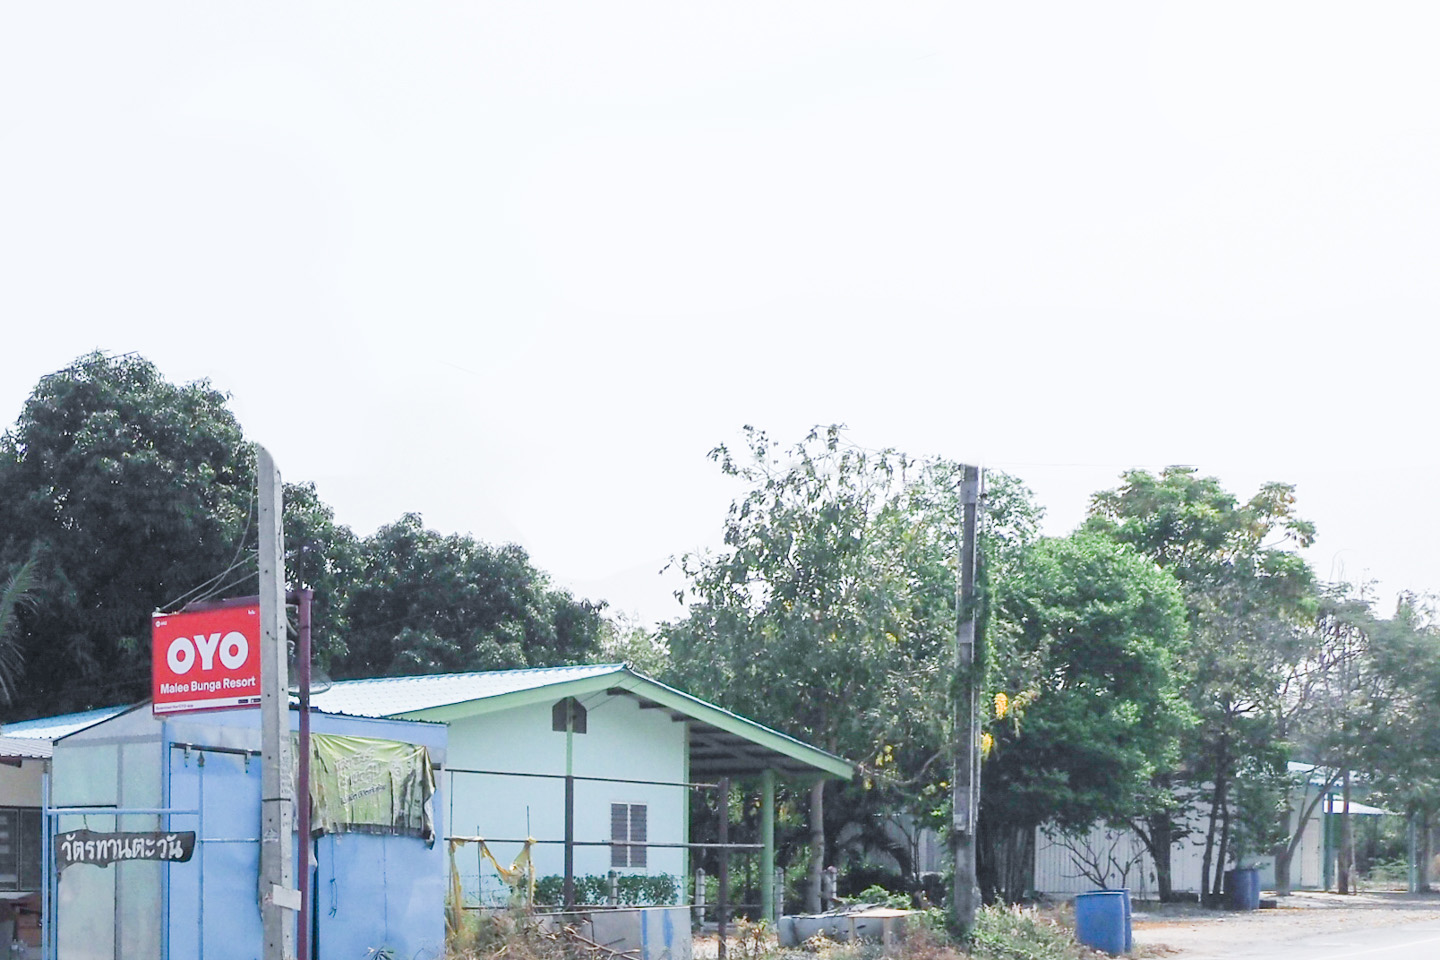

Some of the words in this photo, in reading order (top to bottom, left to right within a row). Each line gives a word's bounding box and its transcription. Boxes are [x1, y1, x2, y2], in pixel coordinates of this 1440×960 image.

[167, 631, 249, 675] OYO
[160, 683, 190, 695] Malee
[190, 680, 221, 693] Bunga
[222, 675, 256, 689] Resort
